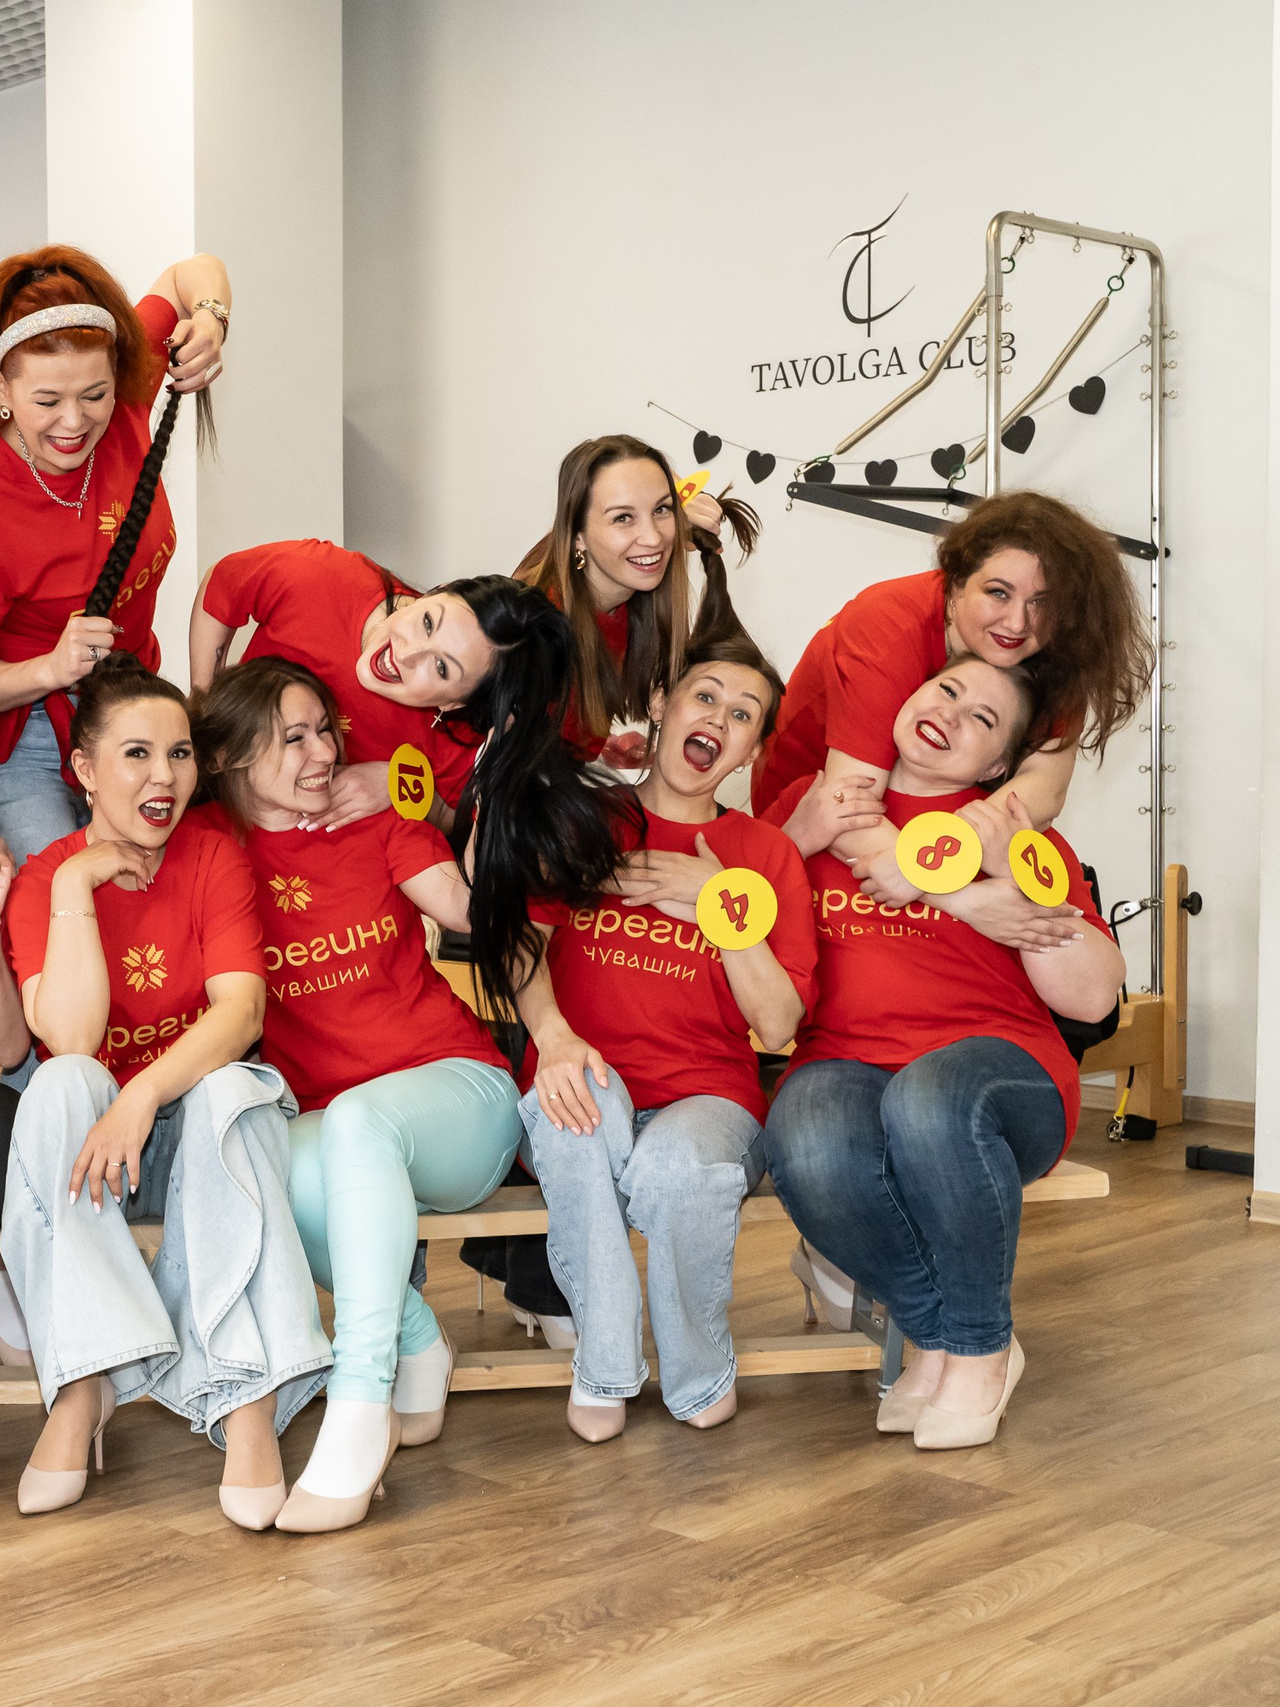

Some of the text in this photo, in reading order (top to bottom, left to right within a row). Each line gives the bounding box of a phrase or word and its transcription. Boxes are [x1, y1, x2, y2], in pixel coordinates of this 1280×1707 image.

[751, 346, 907, 393] TAVOLGA
[397, 763, 425, 804] 12
[916, 835, 962, 870] 8
[718, 889, 749, 933] 4
[263, 914, 399, 972] региня
[266, 962, 370, 1003] увашии
[582, 945, 697, 983] чувашии
